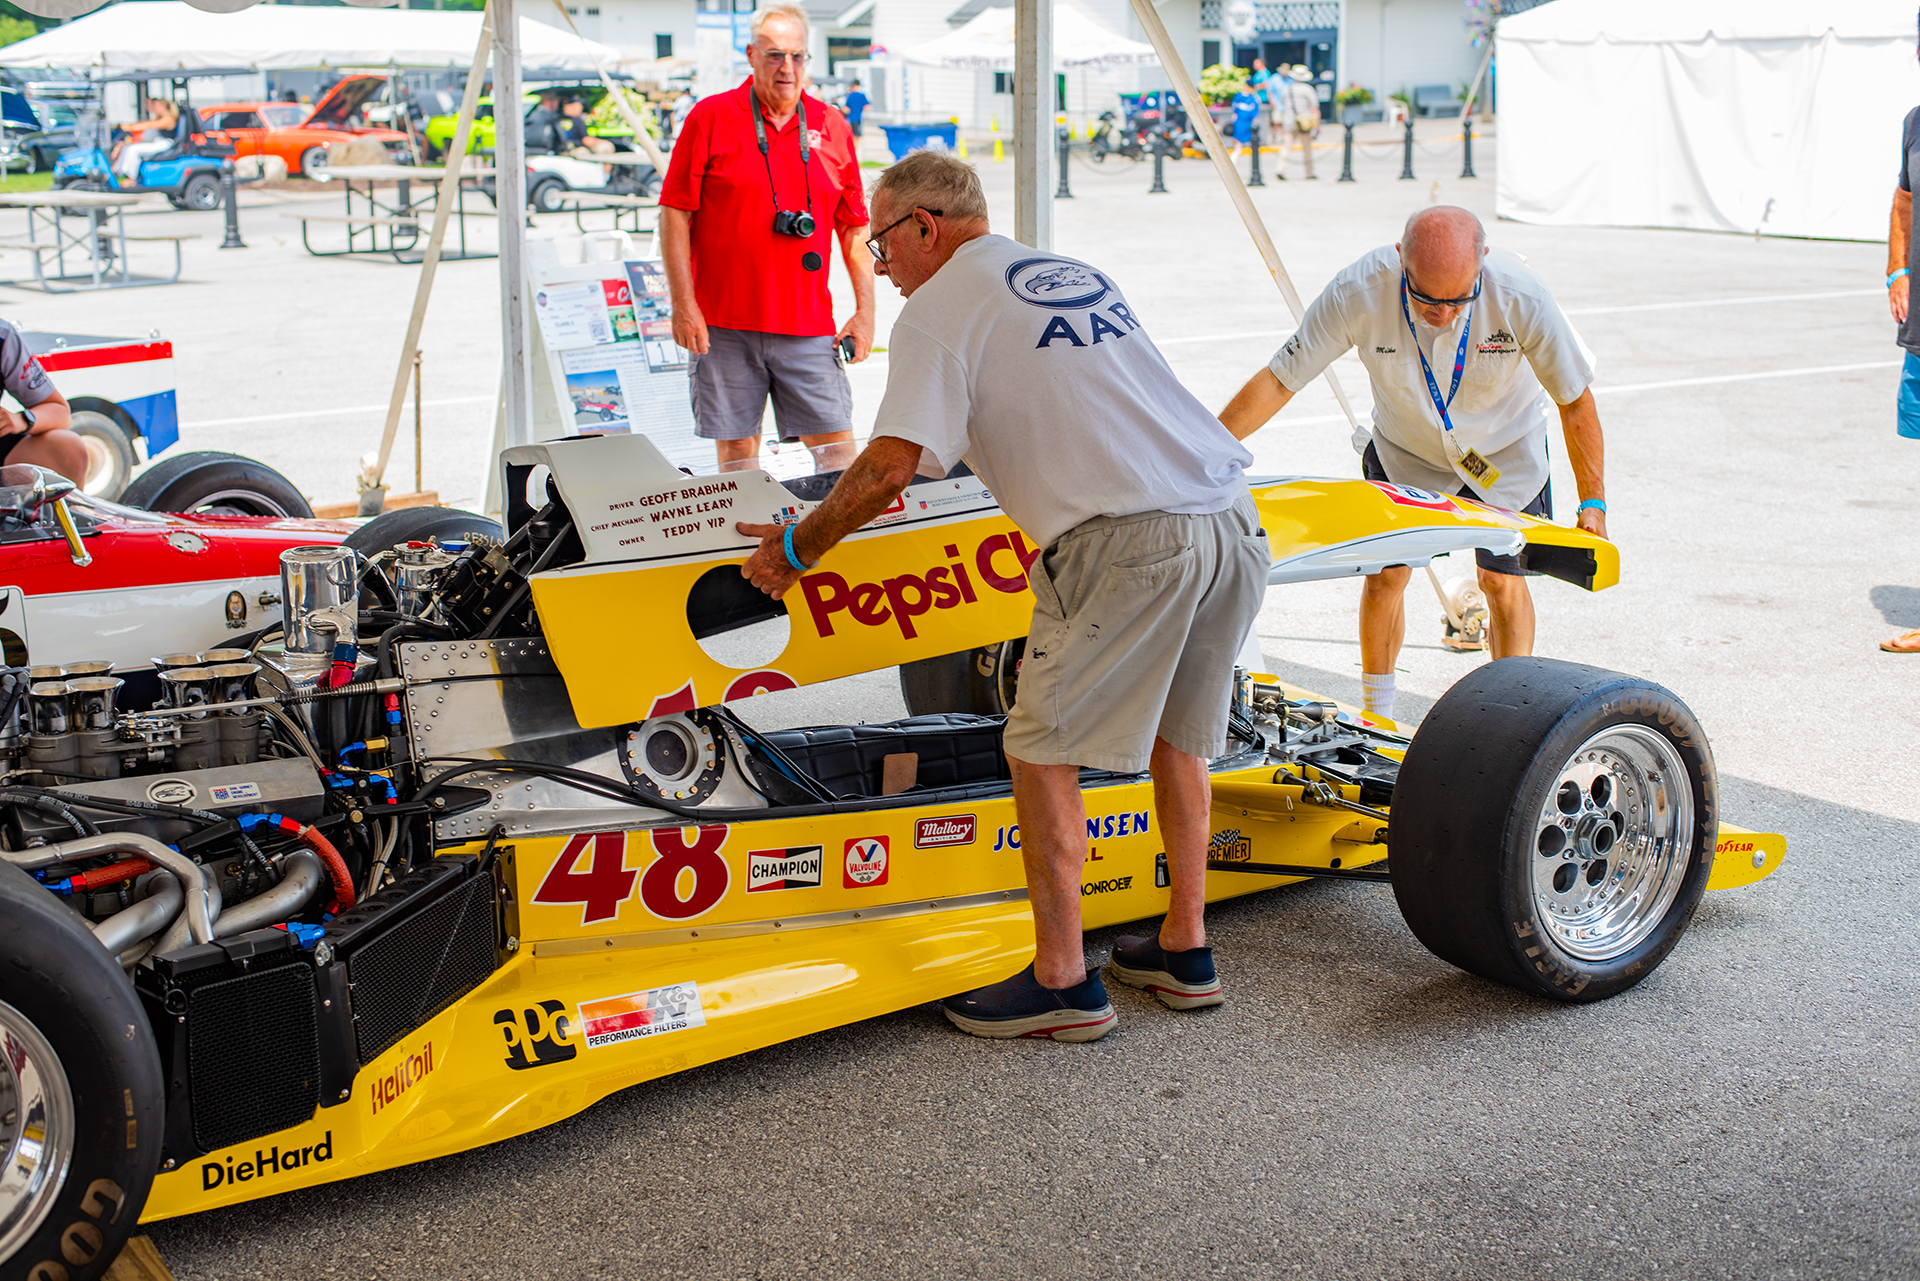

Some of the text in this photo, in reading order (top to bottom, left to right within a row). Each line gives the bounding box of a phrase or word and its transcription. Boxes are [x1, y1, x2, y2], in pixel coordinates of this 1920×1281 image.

[1035, 301, 1141, 349] AAR
[609, 481, 738, 511] DRIVER GEOFF BRABHAM
[590, 497, 734, 532] CHIEF MECHANIC WAYNE LEARY
[619, 517, 726, 546] OWNER TEDDY YIP
[799, 543, 978, 640] Pepsi
[922, 821, 973, 837] Mallory
[530, 824, 731, 927] 48
[752, 859, 818, 879] CHAMPION
[849, 860, 882, 874] VALVOLINE
[588, 1019, 688, 1047] PERFORMANCE FILTERS
[371, 1041, 434, 1116] HeliCoil
[202, 1130, 333, 1191] DieHard
